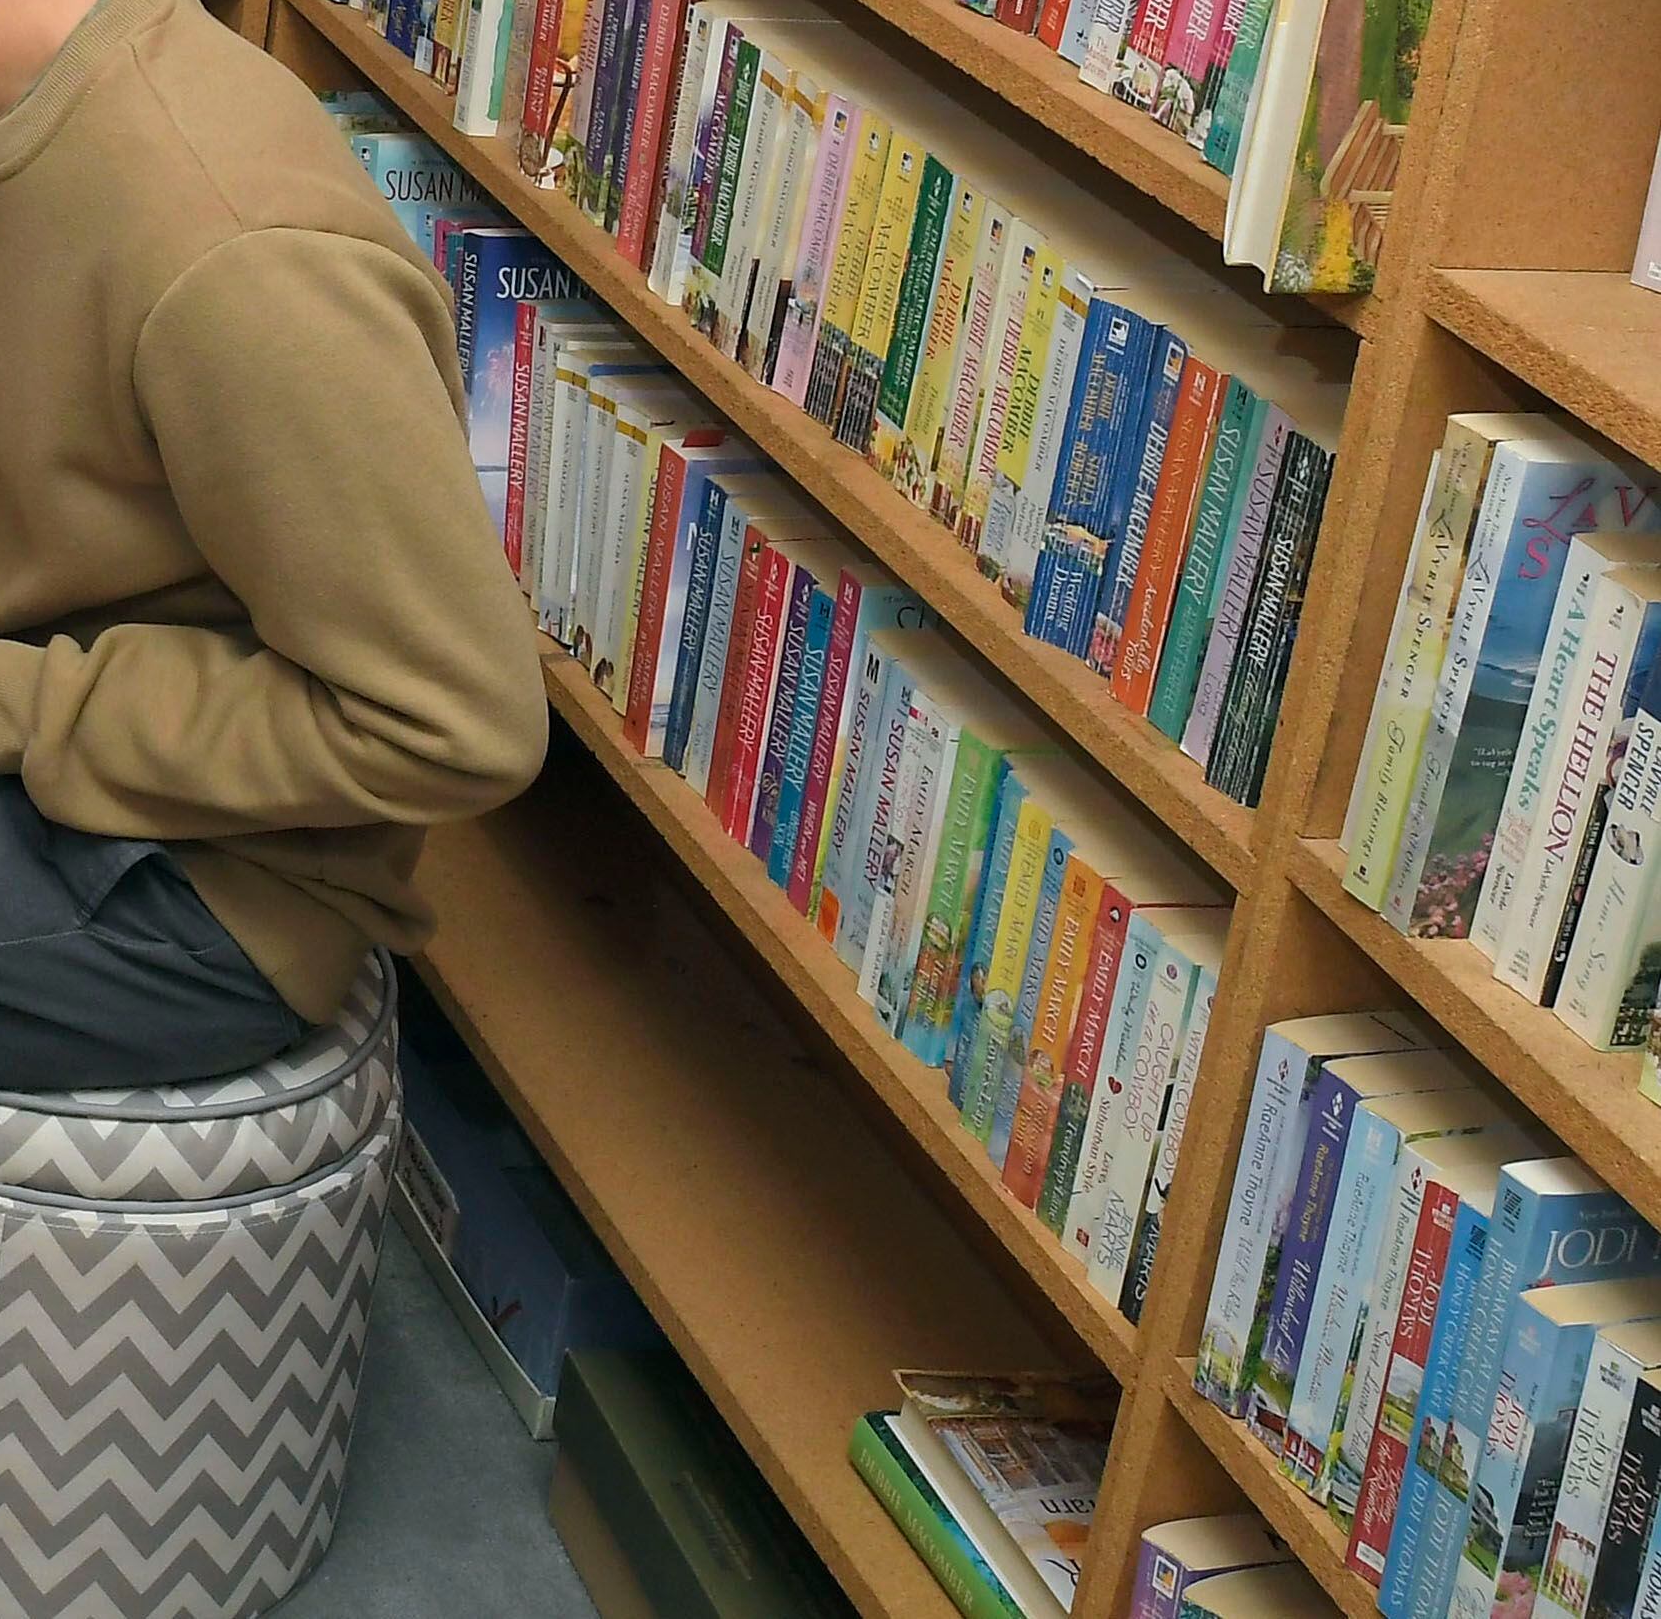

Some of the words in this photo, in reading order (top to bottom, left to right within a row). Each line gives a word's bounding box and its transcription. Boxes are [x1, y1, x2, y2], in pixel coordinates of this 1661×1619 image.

[384, 168, 456, 203] SUSAN
[496, 266, 571, 300] SUSAN
[1216, 418, 1245, 484] SUSAN
[1184, 486, 1225, 604] MALLERY
[753, 611, 776, 670] SUSAN
[739, 671, 763, 752] MALLERY
[1061, 915, 1083, 971] EMILY
[1044, 973, 1073, 1045] MARCH
[1088, 955, 1112, 1013] EMILY
[1075, 1014, 1100, 1080] MARCH
[1549, 1229, 1636, 1270] JODI
[1399, 1248, 1433, 1340] THOMAS
[1411, 1251, 1439, 1329] JODI
